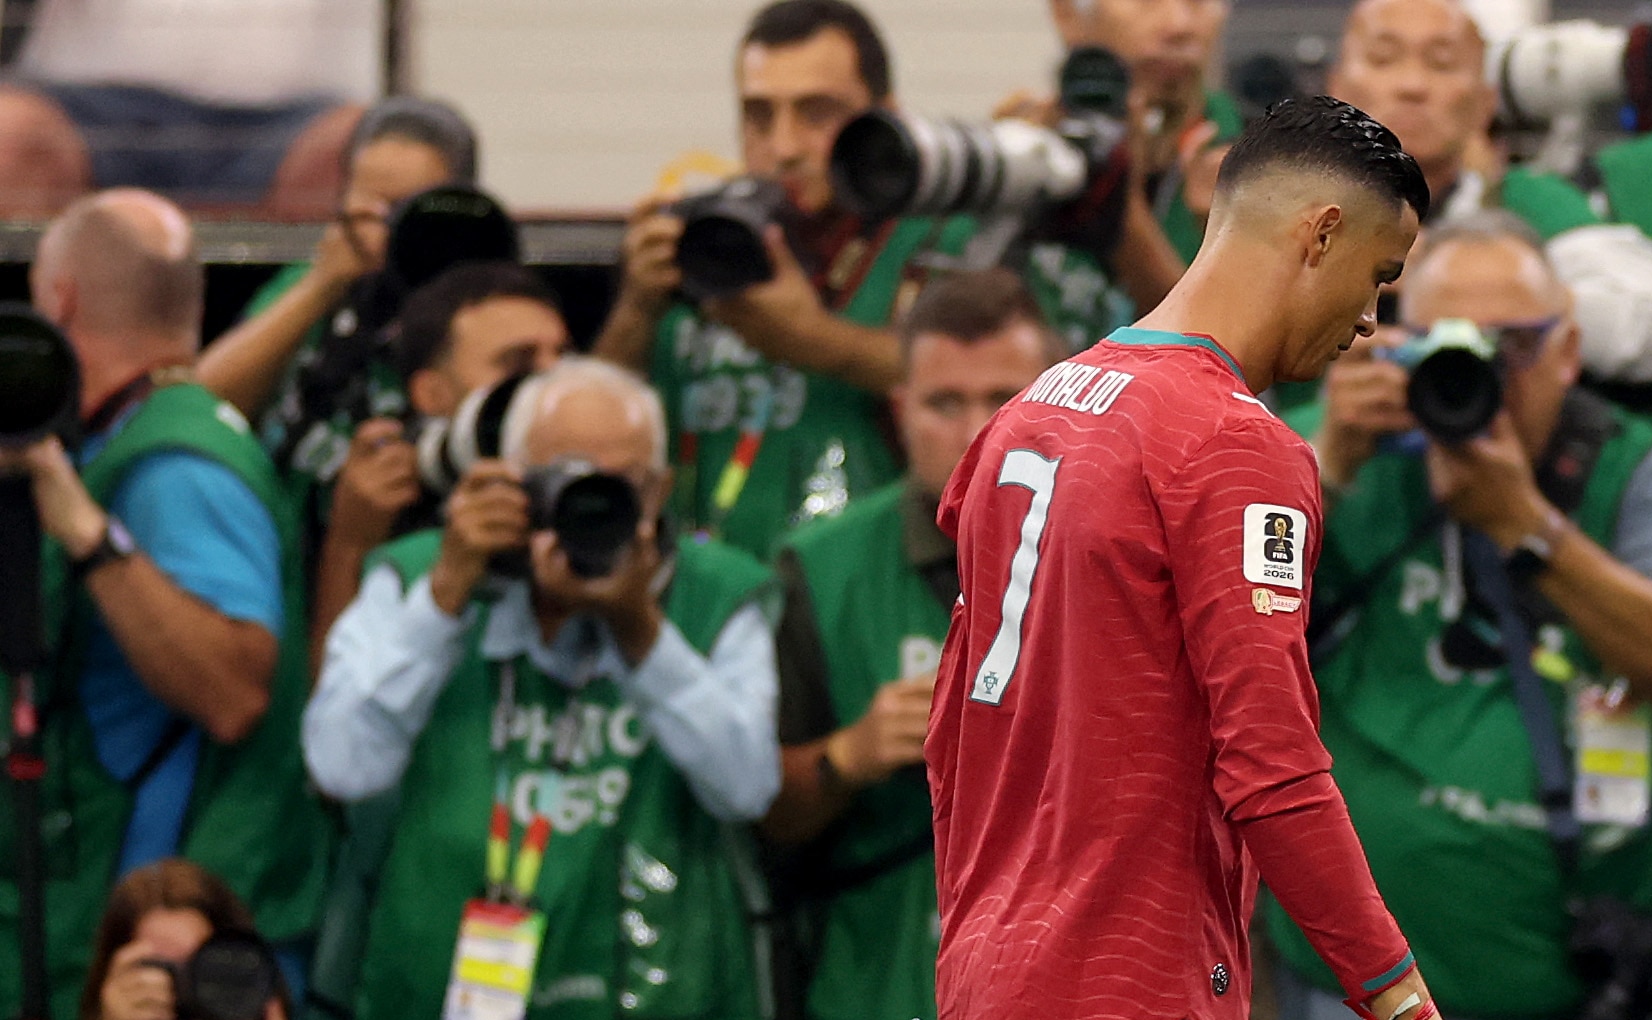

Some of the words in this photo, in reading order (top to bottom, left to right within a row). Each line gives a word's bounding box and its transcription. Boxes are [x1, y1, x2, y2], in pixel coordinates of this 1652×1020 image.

[1272, 551, 1289, 560] FIFA
[969, 449, 1064, 706] 7
[1263, 569, 1295, 581] 2026
